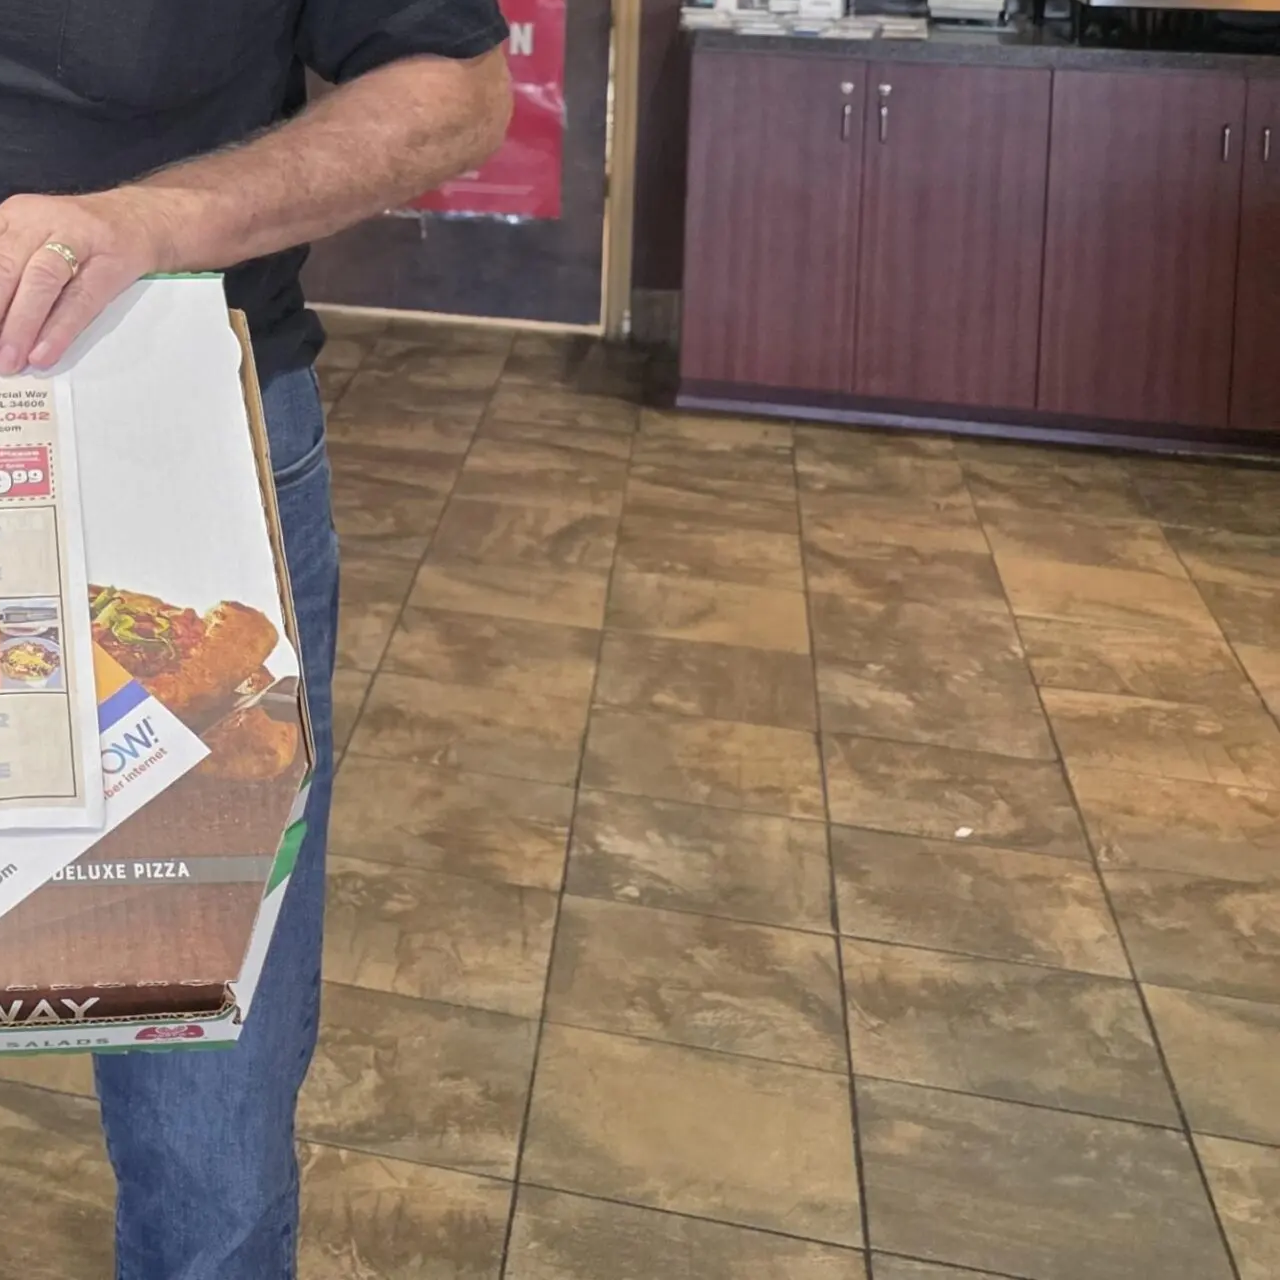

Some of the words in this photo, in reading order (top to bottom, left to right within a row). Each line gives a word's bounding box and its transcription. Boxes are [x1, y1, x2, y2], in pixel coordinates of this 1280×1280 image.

[25, 390, 48, 399] Way
[101, 716, 159, 776] OW!
[124, 746, 169, 783] internet
[52, 863, 127, 882] DELUXE
[133, 861, 191, 878] PIZZA
[5, 1037, 111, 1049] SALADS
